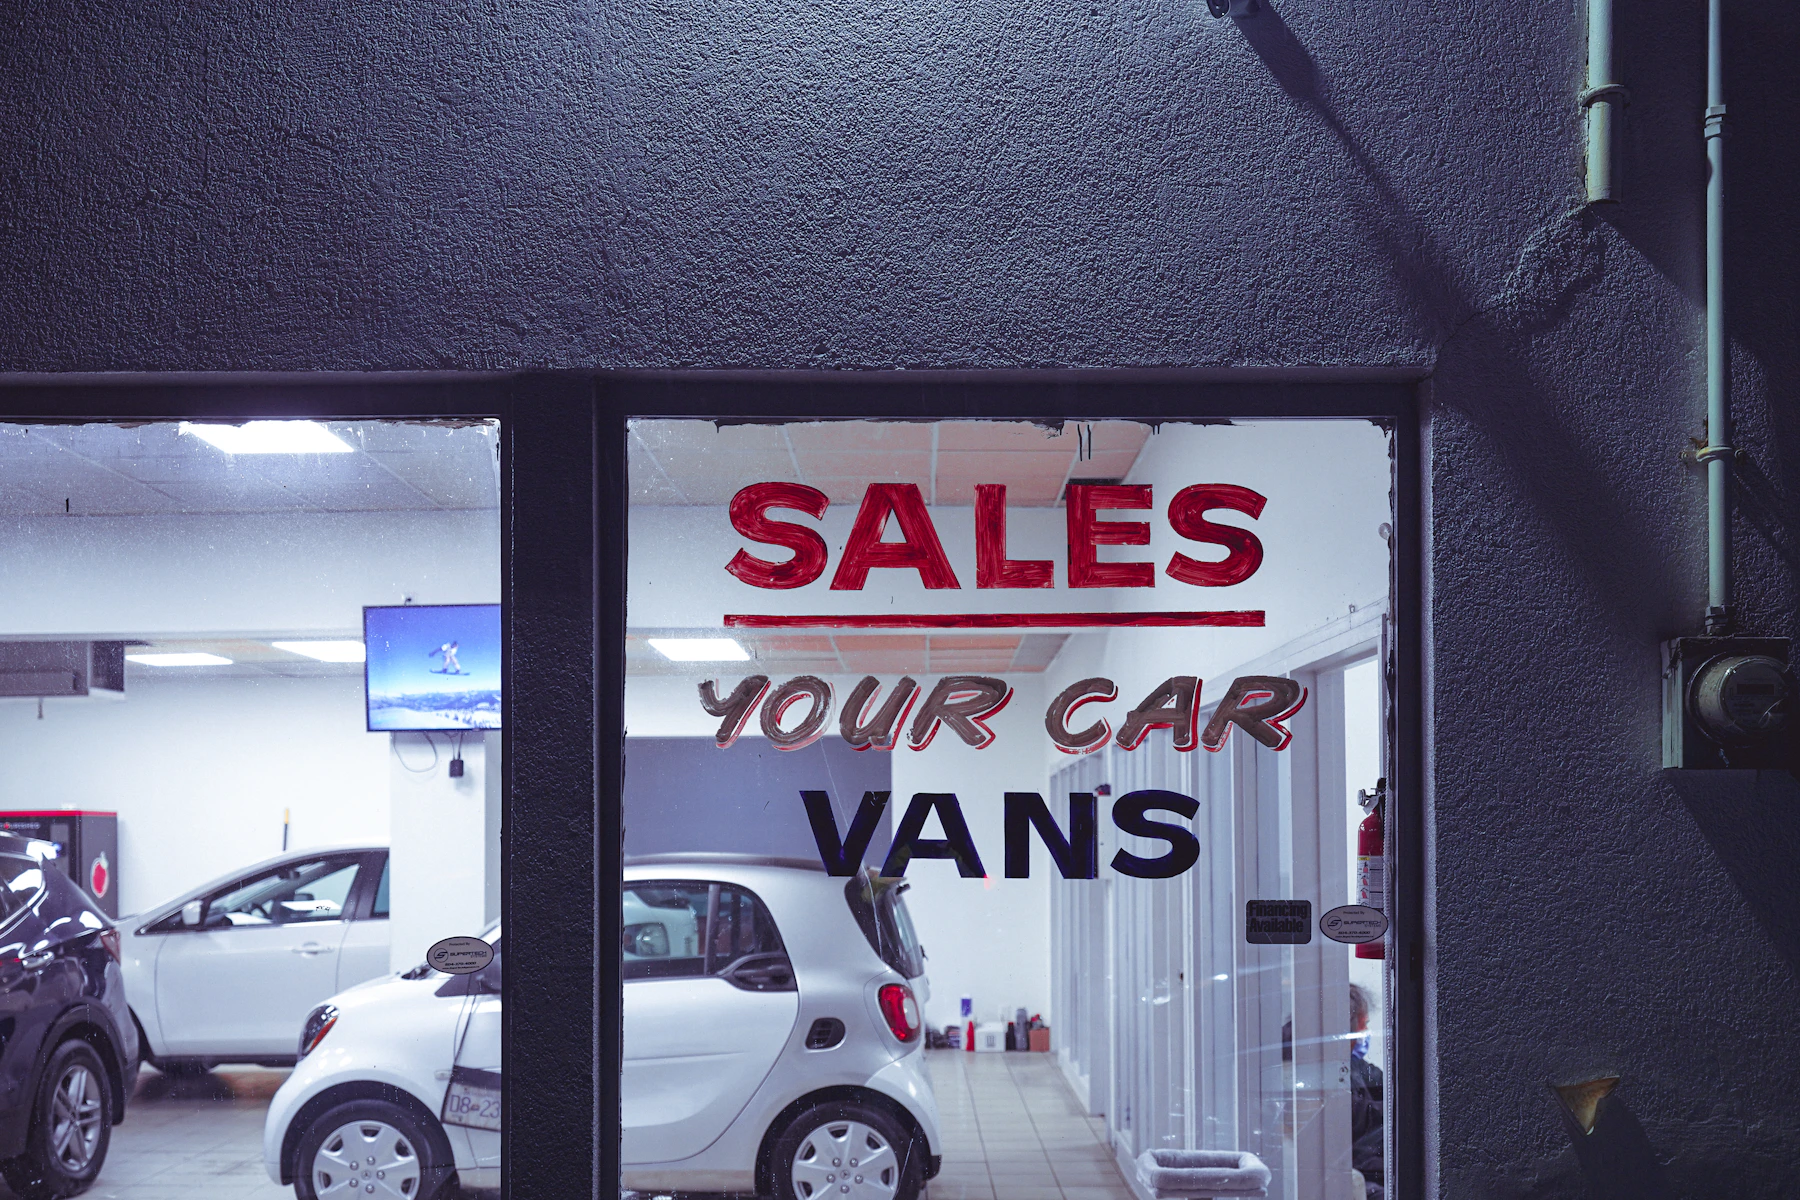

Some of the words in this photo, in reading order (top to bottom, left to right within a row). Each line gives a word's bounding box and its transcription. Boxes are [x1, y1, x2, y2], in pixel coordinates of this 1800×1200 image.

[725, 481, 1268, 590] SALES
[698, 674, 1014, 752] YOUR
[1044, 674, 1309, 755] CAR
[799, 789, 1201, 880] VANS
[1249, 902, 1308, 919] Financing
[1249, 917, 1304, 933] Available
